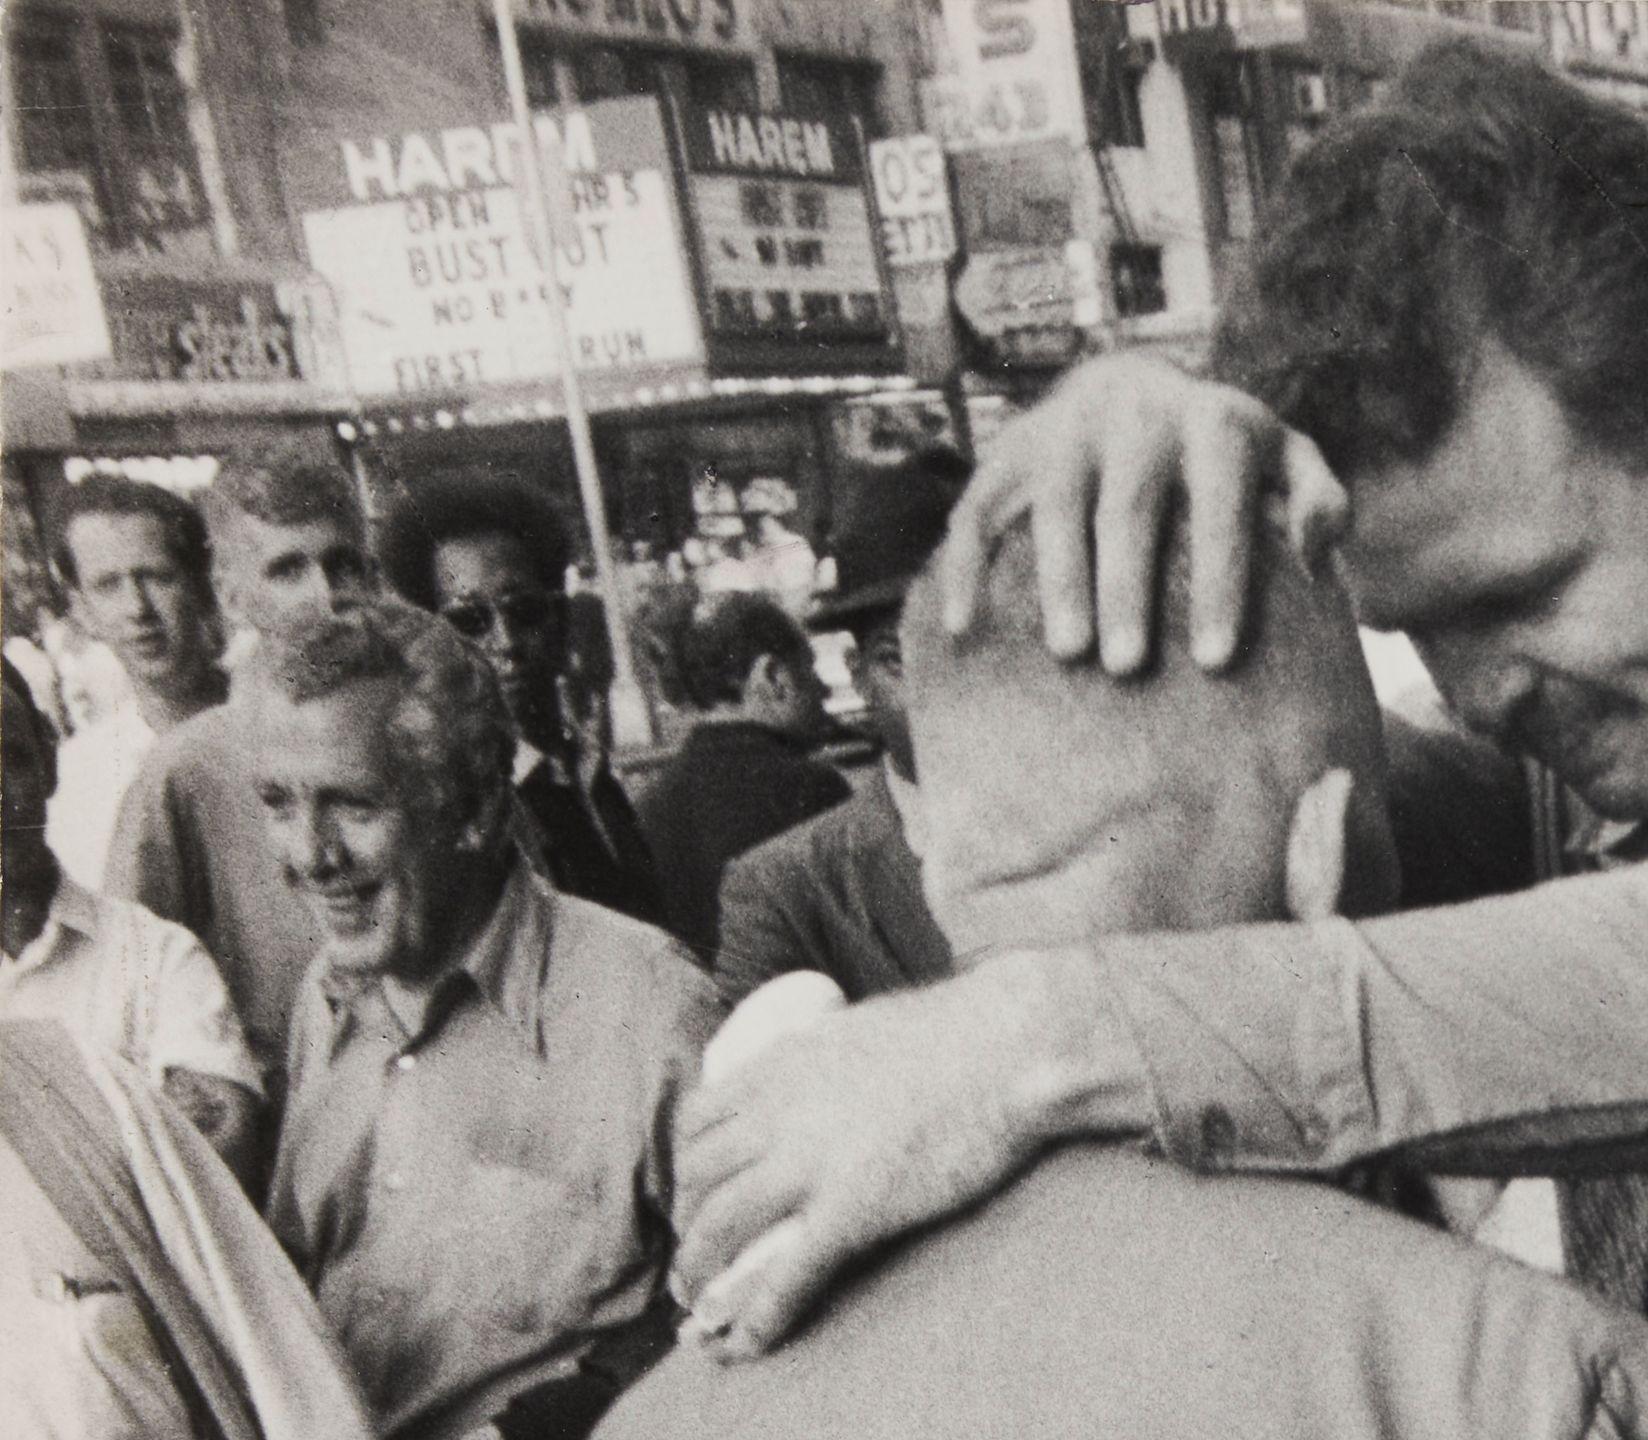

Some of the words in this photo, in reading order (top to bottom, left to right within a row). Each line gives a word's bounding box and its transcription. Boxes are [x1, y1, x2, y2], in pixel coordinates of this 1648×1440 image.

[707, 111, 834, 174] HAREM
[404, 188, 491, 235] OPEN
[406, 236, 509, 288] BUST
[432, 294, 475, 327] NO
[392, 348, 484, 393] FIRST
[579, 330, 648, 372] RUN
